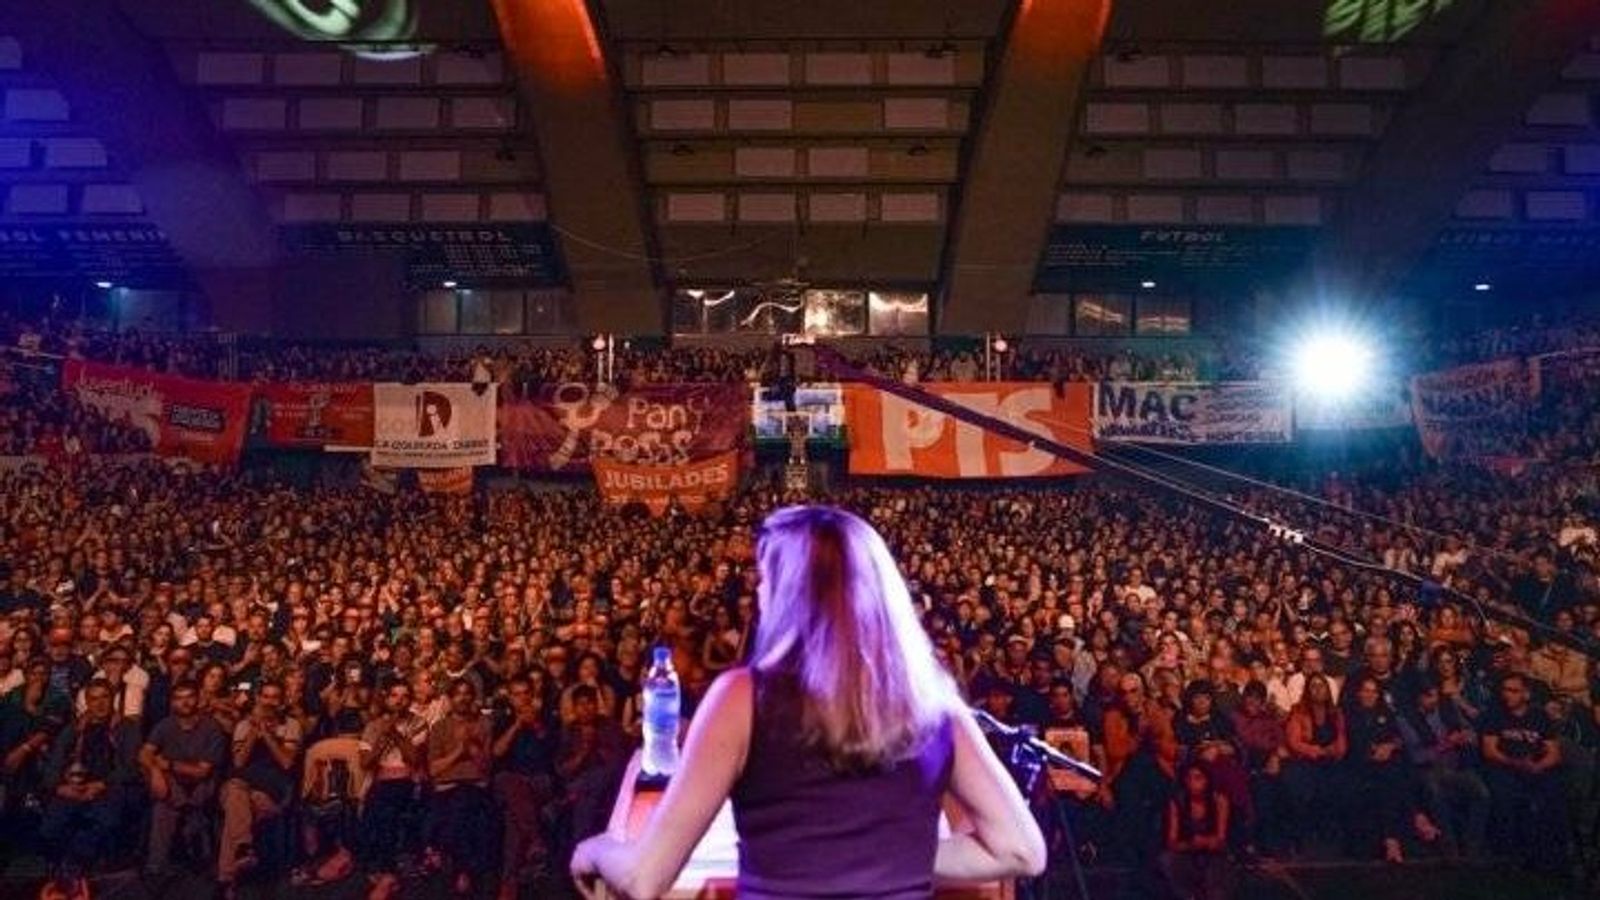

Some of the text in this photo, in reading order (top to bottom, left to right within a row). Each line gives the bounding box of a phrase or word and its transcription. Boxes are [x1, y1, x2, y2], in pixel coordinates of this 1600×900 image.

[627, 397, 688, 430] Pan
[1098, 381, 1200, 421] MAC
[879, 386, 1056, 476] PTS
[603, 464, 730, 492] JUBILADES
